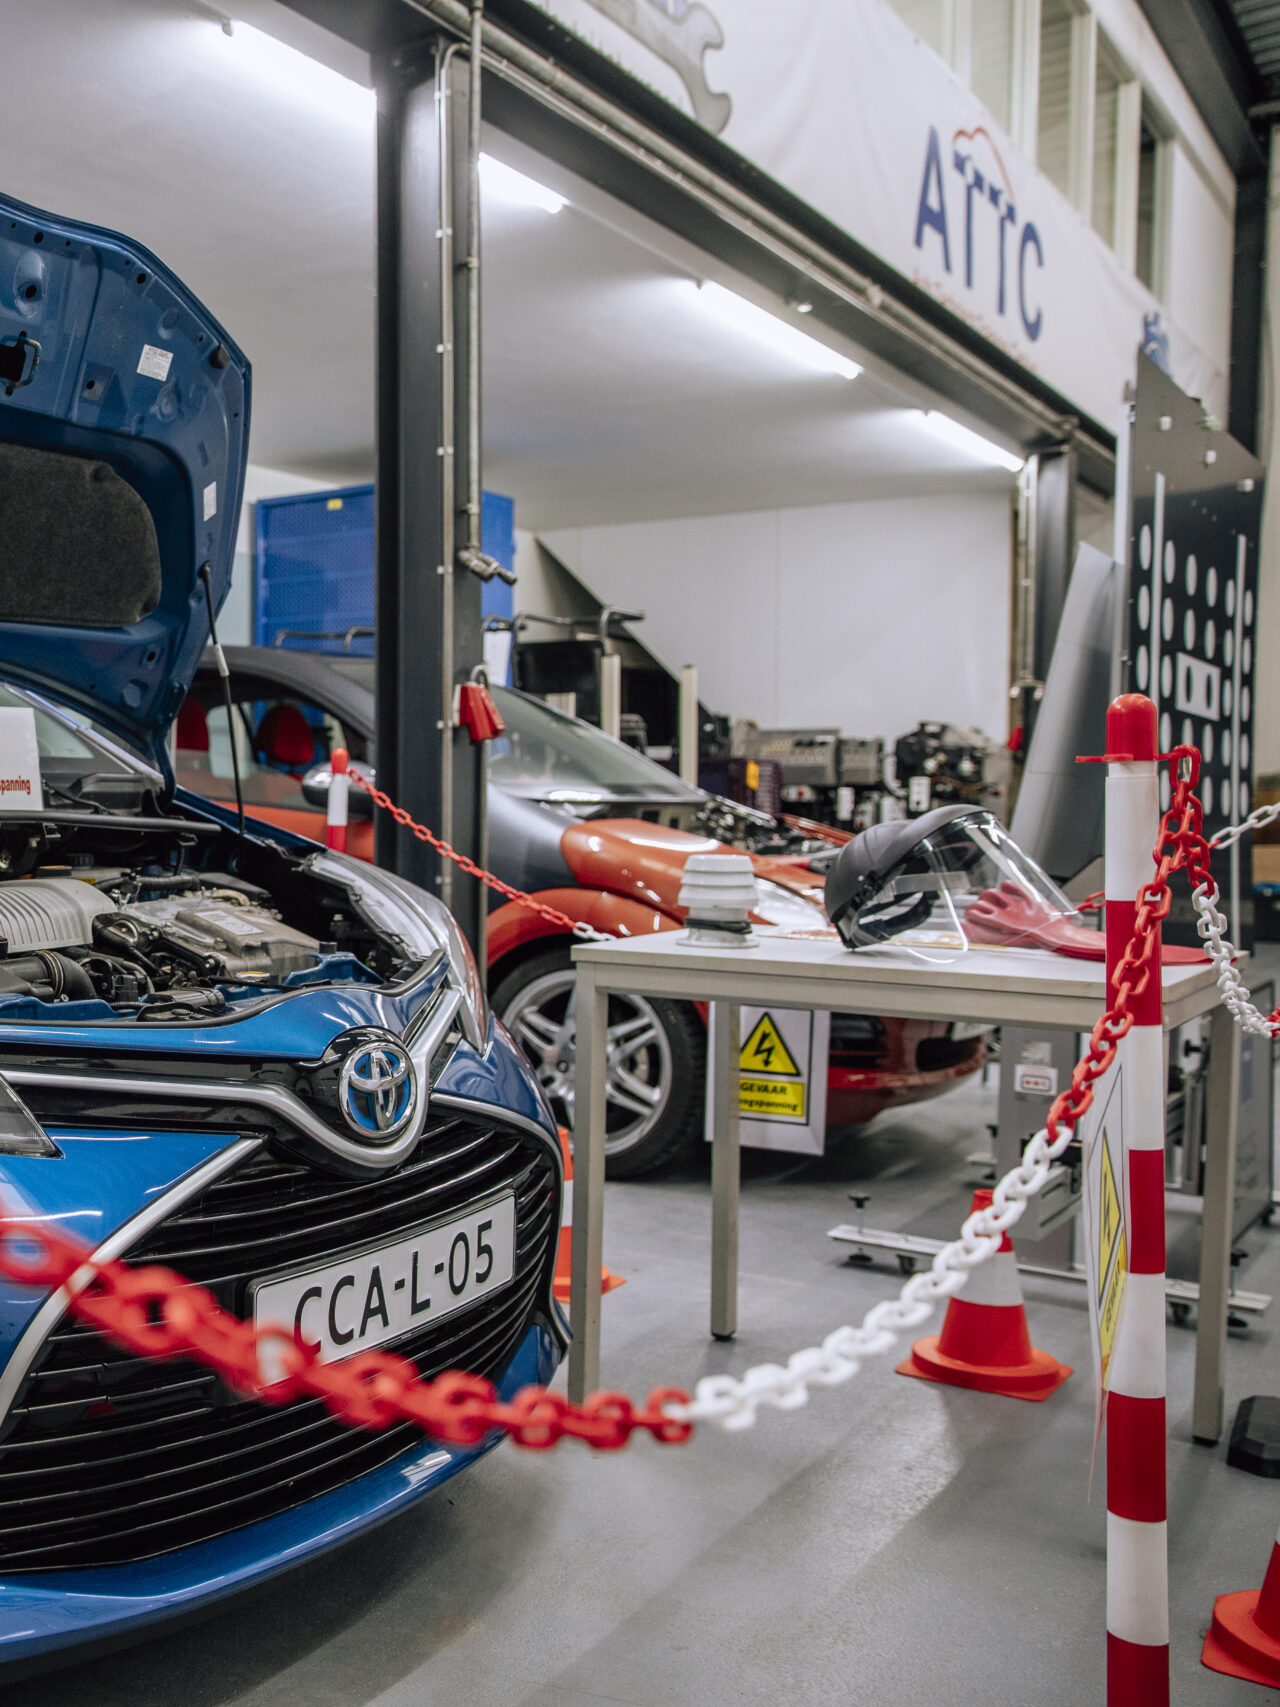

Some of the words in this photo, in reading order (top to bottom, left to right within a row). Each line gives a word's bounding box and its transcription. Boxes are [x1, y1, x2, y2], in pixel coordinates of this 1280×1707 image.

[914, 124, 1044, 342] ATTC
[739, 1081, 787, 1095] GEVAAR
[293, 1218, 494, 1353] CCA-L-05
